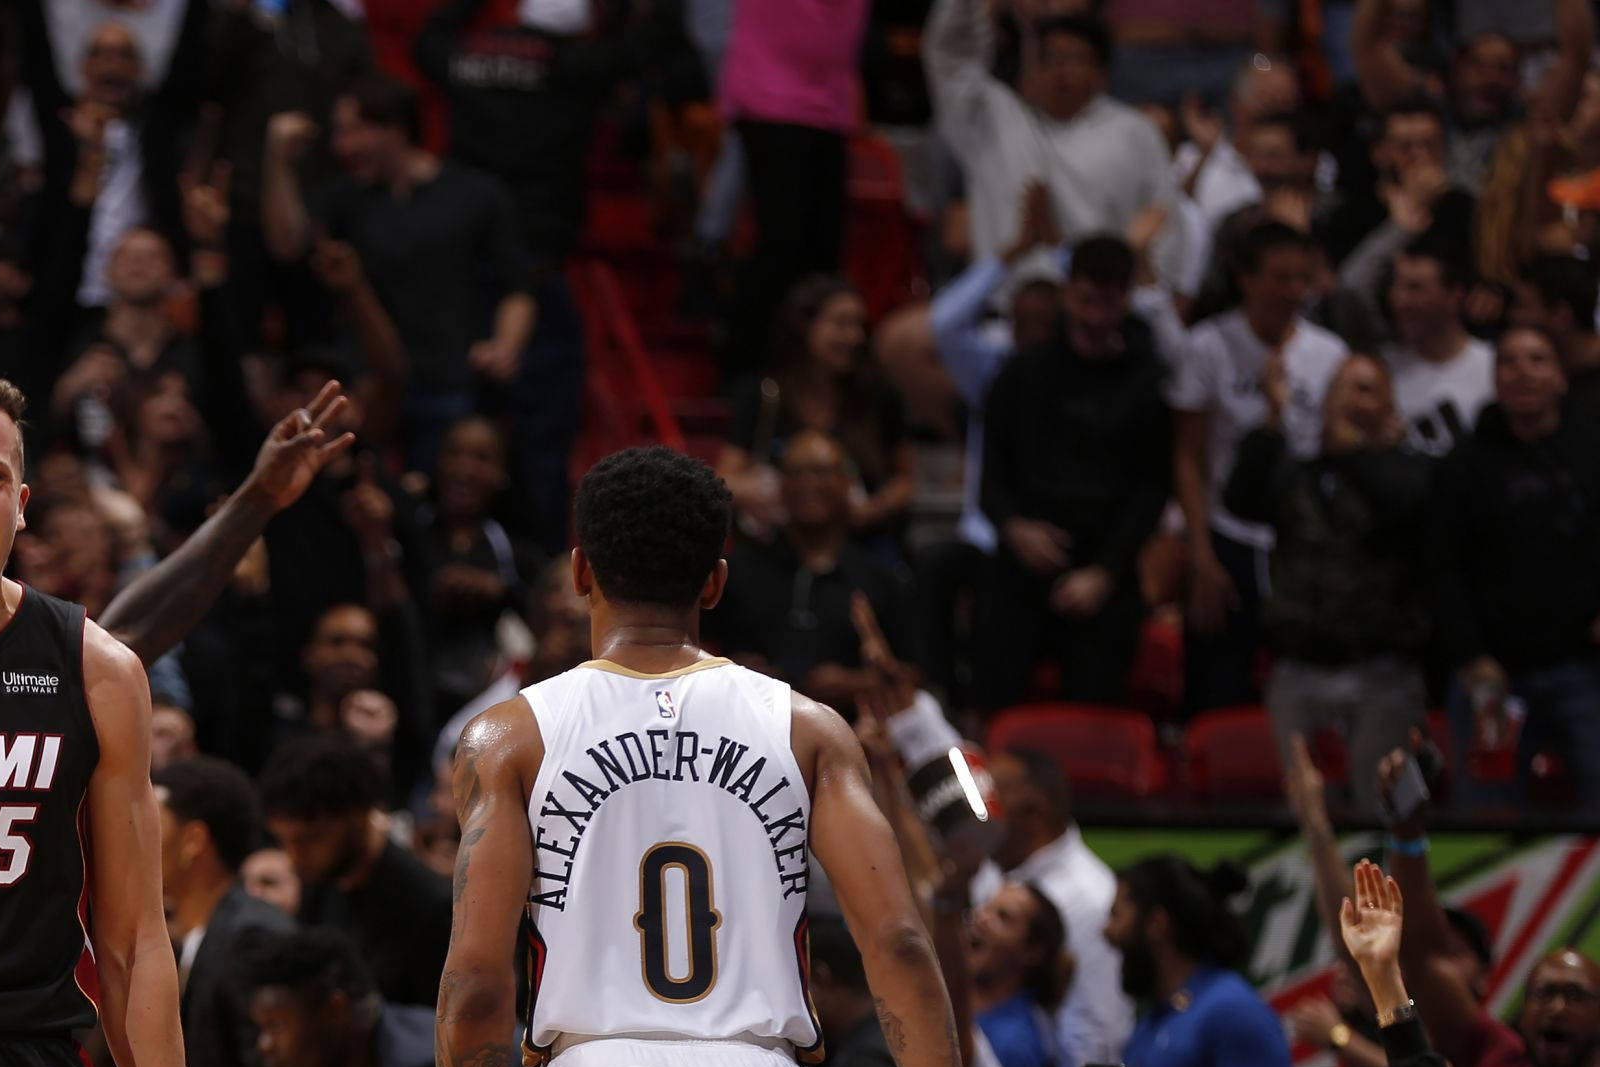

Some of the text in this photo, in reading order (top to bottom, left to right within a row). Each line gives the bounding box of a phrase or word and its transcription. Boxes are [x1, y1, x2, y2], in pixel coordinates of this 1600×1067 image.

[2, 671, 59, 686] Ultimate
[6, 685, 58, 694] SOFTWARE
[530, 729, 811, 912] ALEXANDER-WALKER
[633, 841, 723, 1004] 0
